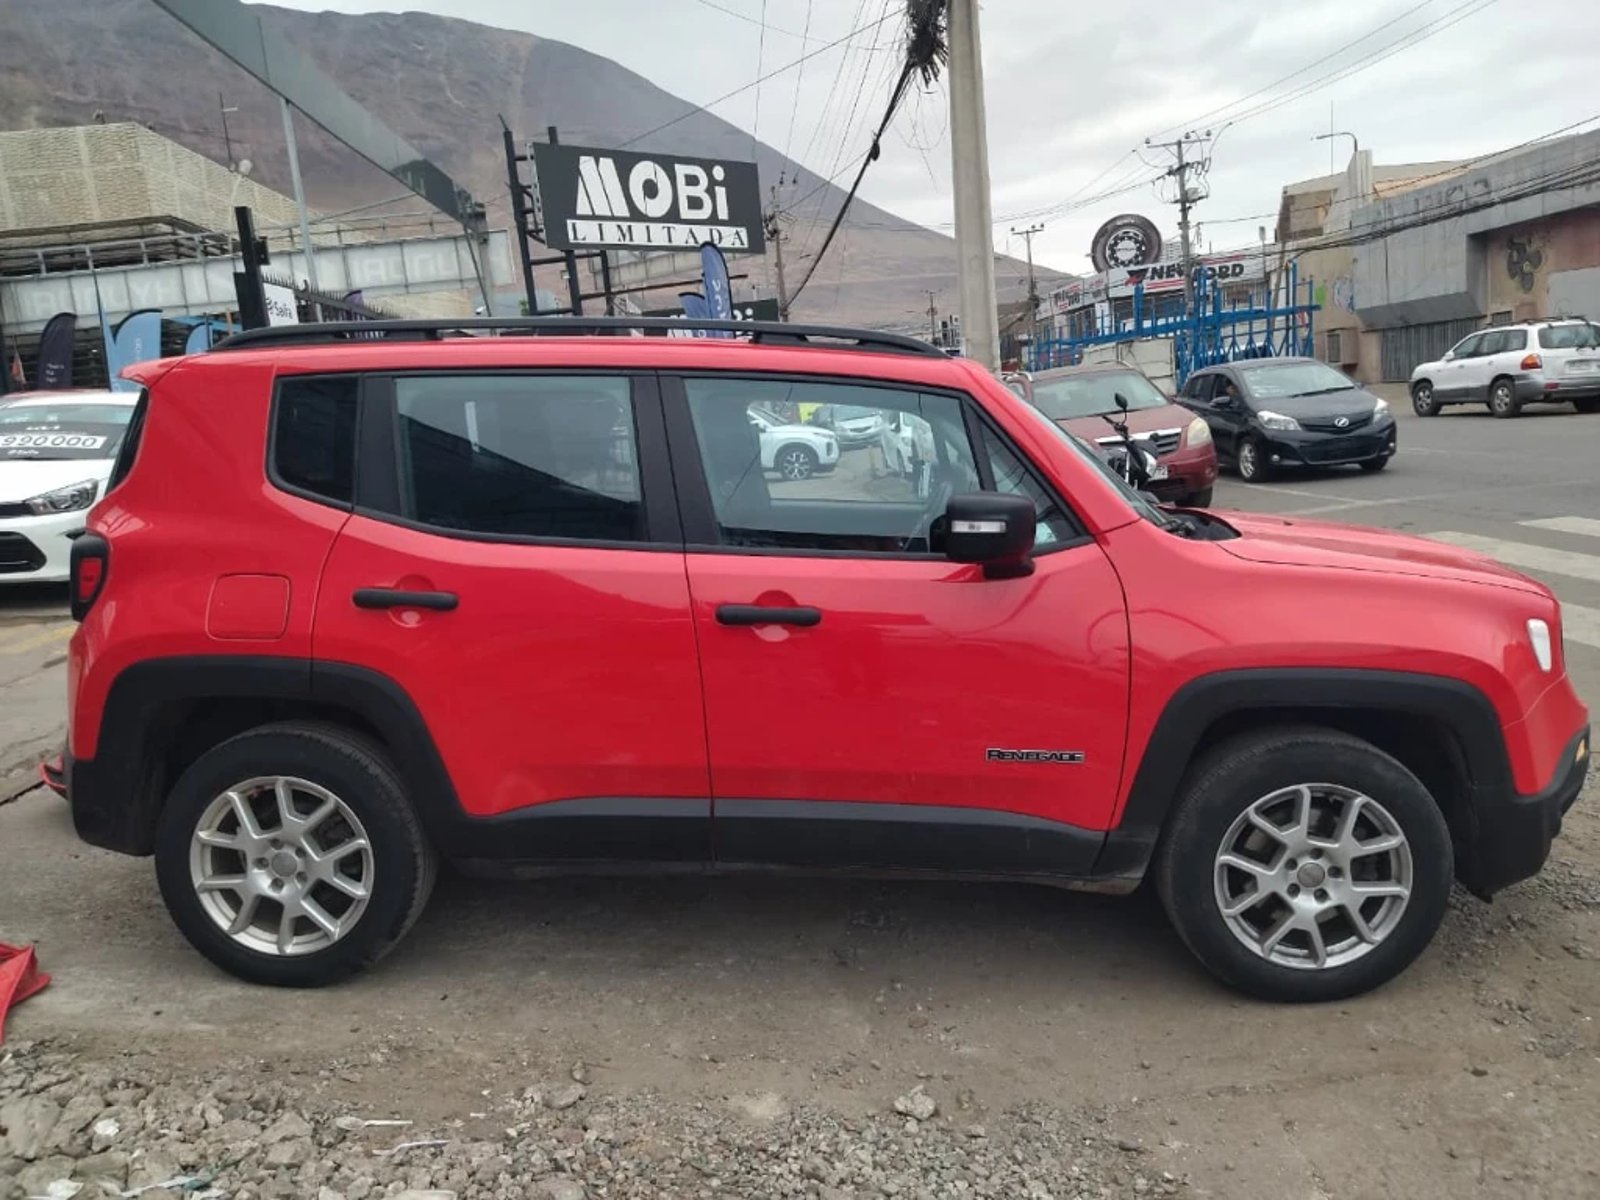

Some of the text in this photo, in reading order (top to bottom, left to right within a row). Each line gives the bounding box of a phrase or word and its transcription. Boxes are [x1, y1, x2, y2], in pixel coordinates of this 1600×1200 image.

[576, 156, 729, 221] MOBi
[571, 222, 746, 246] LIMITADA
[986, 748, 1084, 763] RENEGADE
